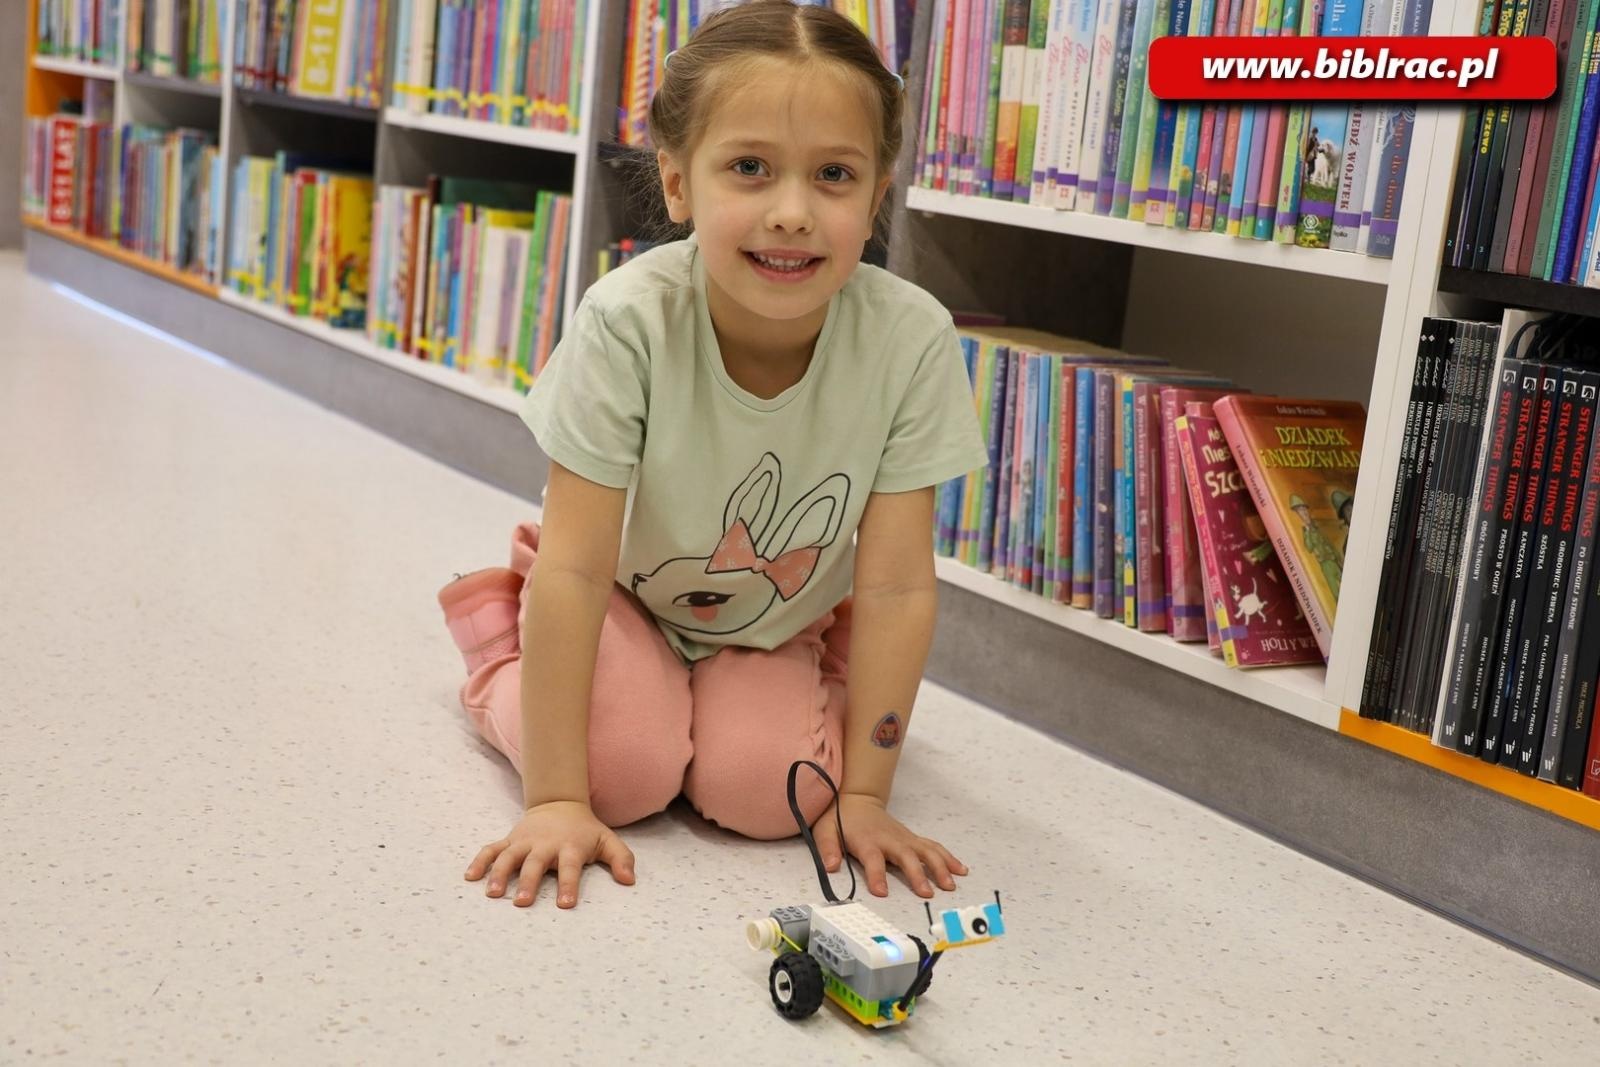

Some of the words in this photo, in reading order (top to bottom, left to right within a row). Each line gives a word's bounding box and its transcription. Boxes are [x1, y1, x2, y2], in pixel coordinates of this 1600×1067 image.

[1339, 150, 1357, 209] WOJTEK
[1404, 400, 1415, 434] HERKULES
[1412, 401, 1424, 435] HERKULES
[1424, 404, 1432, 417] NIE
[1431, 403, 1443, 438] HERKULES
[1491, 389, 1512, 461] STRANGER
[1275, 426, 1352, 446] DZIADEK
[1409, 436, 1418, 459] POIROT
[1428, 438, 1437, 461] POIROT
[1510, 398, 1531, 469] STRANGER
[1530, 399, 1551, 470] STRANGER
[1551, 401, 1572, 472] STRANGER
[1569, 406, 1591, 478] STRANGER
[1415, 447, 1425, 473] NIKOGO
[1482, 463, 1499, 513] THINGS
[1501, 472, 1519, 521] THINGS
[1521, 474, 1539, 523] THINGS
[1542, 478, 1559, 526] THINGS
[1560, 482, 1577, 532] THINGS
[1581, 488, 1598, 538] THINGS
[1478, 520, 1489, 541] OBÓZ
[1496, 528, 1507, 559] PROSTO
[1471, 543, 1484, 581] NAUKOWY
[1514, 530, 1528, 578] KAMCZATKA
[1536, 534, 1549, 570] SZÓSTKA
[1551, 540, 1566, 588] GROBOWIEC
[1578, 545, 1586, 557] PO
[1275, 537, 1295, 573] DZIADEK
[1293, 577, 1324, 634] NIEDŹWIADEK
[1572, 560, 1584, 594] DRUGIEJ
[1567, 597, 1578, 629] STRONIE
[1260, 637, 1297, 652] HOLLY
[1502, 628, 1511, 654] HRISTOV
[1455, 653, 1464, 682] SALAZAR
[1496, 661, 1506, 689] JACKSON
[1537, 652, 1546, 679] GALINDO
[1515, 670, 1524, 699] SALAZAR
[1532, 684, 1541, 708] SEGALA
